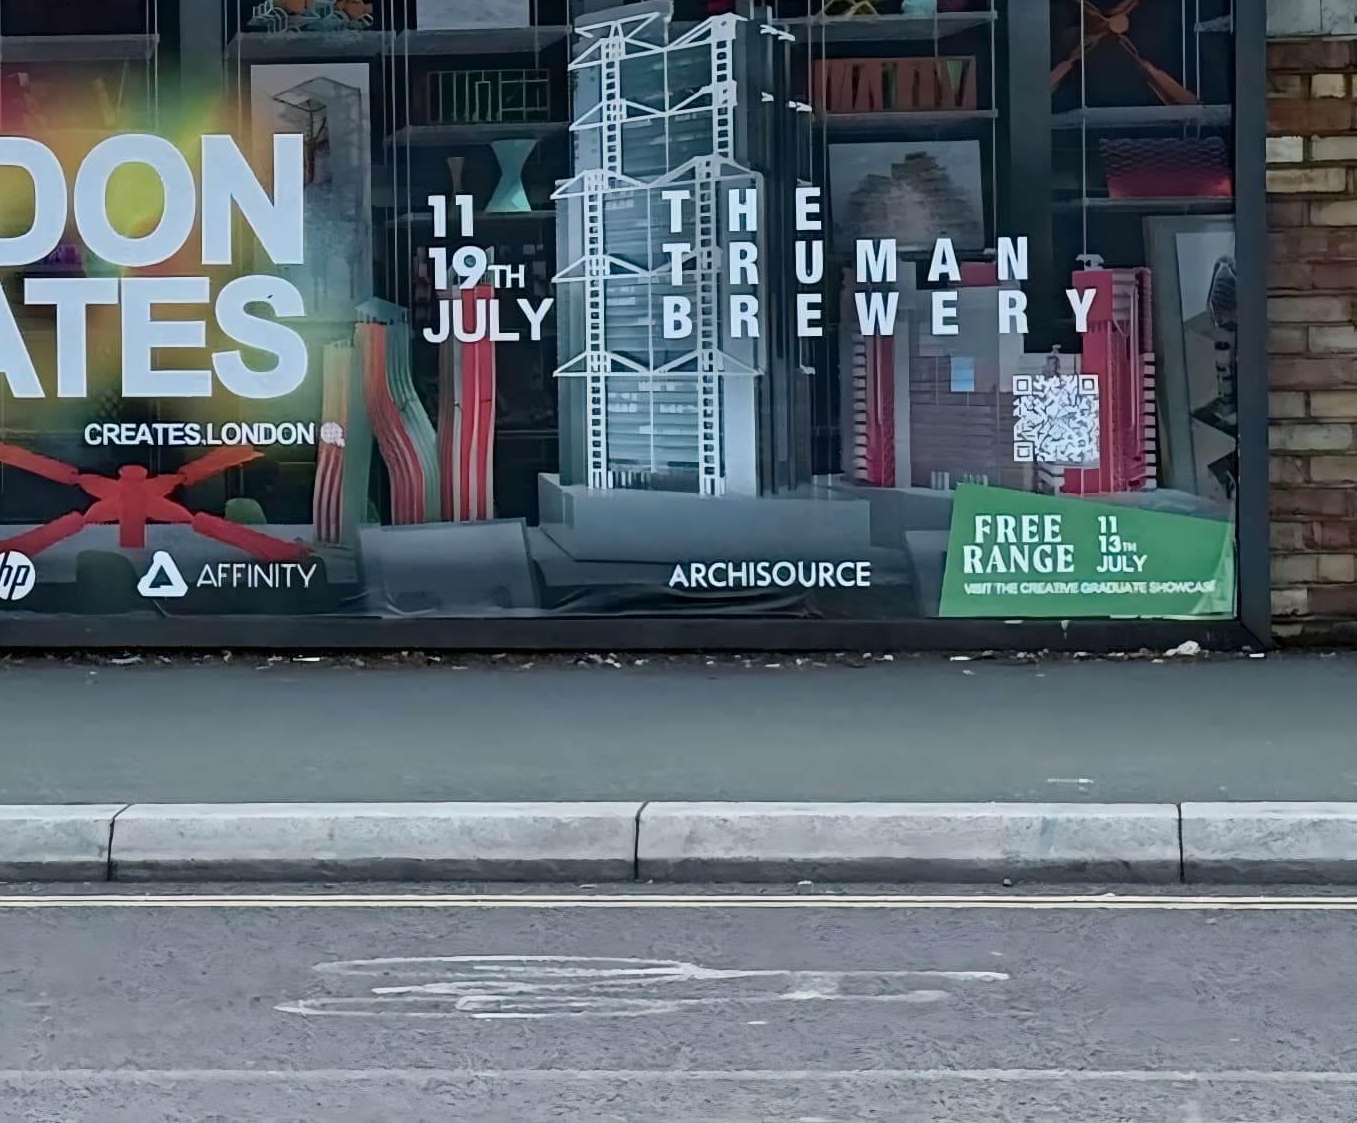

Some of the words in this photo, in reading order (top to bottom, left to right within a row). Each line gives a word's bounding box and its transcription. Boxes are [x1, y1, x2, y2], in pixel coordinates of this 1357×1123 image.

[427, 194, 474, 238] 11
[662, 187, 822, 233] THE
[428, 246, 525, 290] 19TH
[662, 236, 1029, 286] TRUMAN
[423, 298, 555, 343] JULY
[663, 288, 1097, 339] BREWERY
[84, 422, 315, 445] CREATES.LONDON
[974, 514, 1062, 544] FREE
[1097, 515, 1117, 533] 11
[963, 544, 1074, 573] RANGE
[1096, 554, 1148, 573] JULY
[196, 563, 317, 588] AFFINITY
[669, 561, 871, 588] ARCHISOURCE
